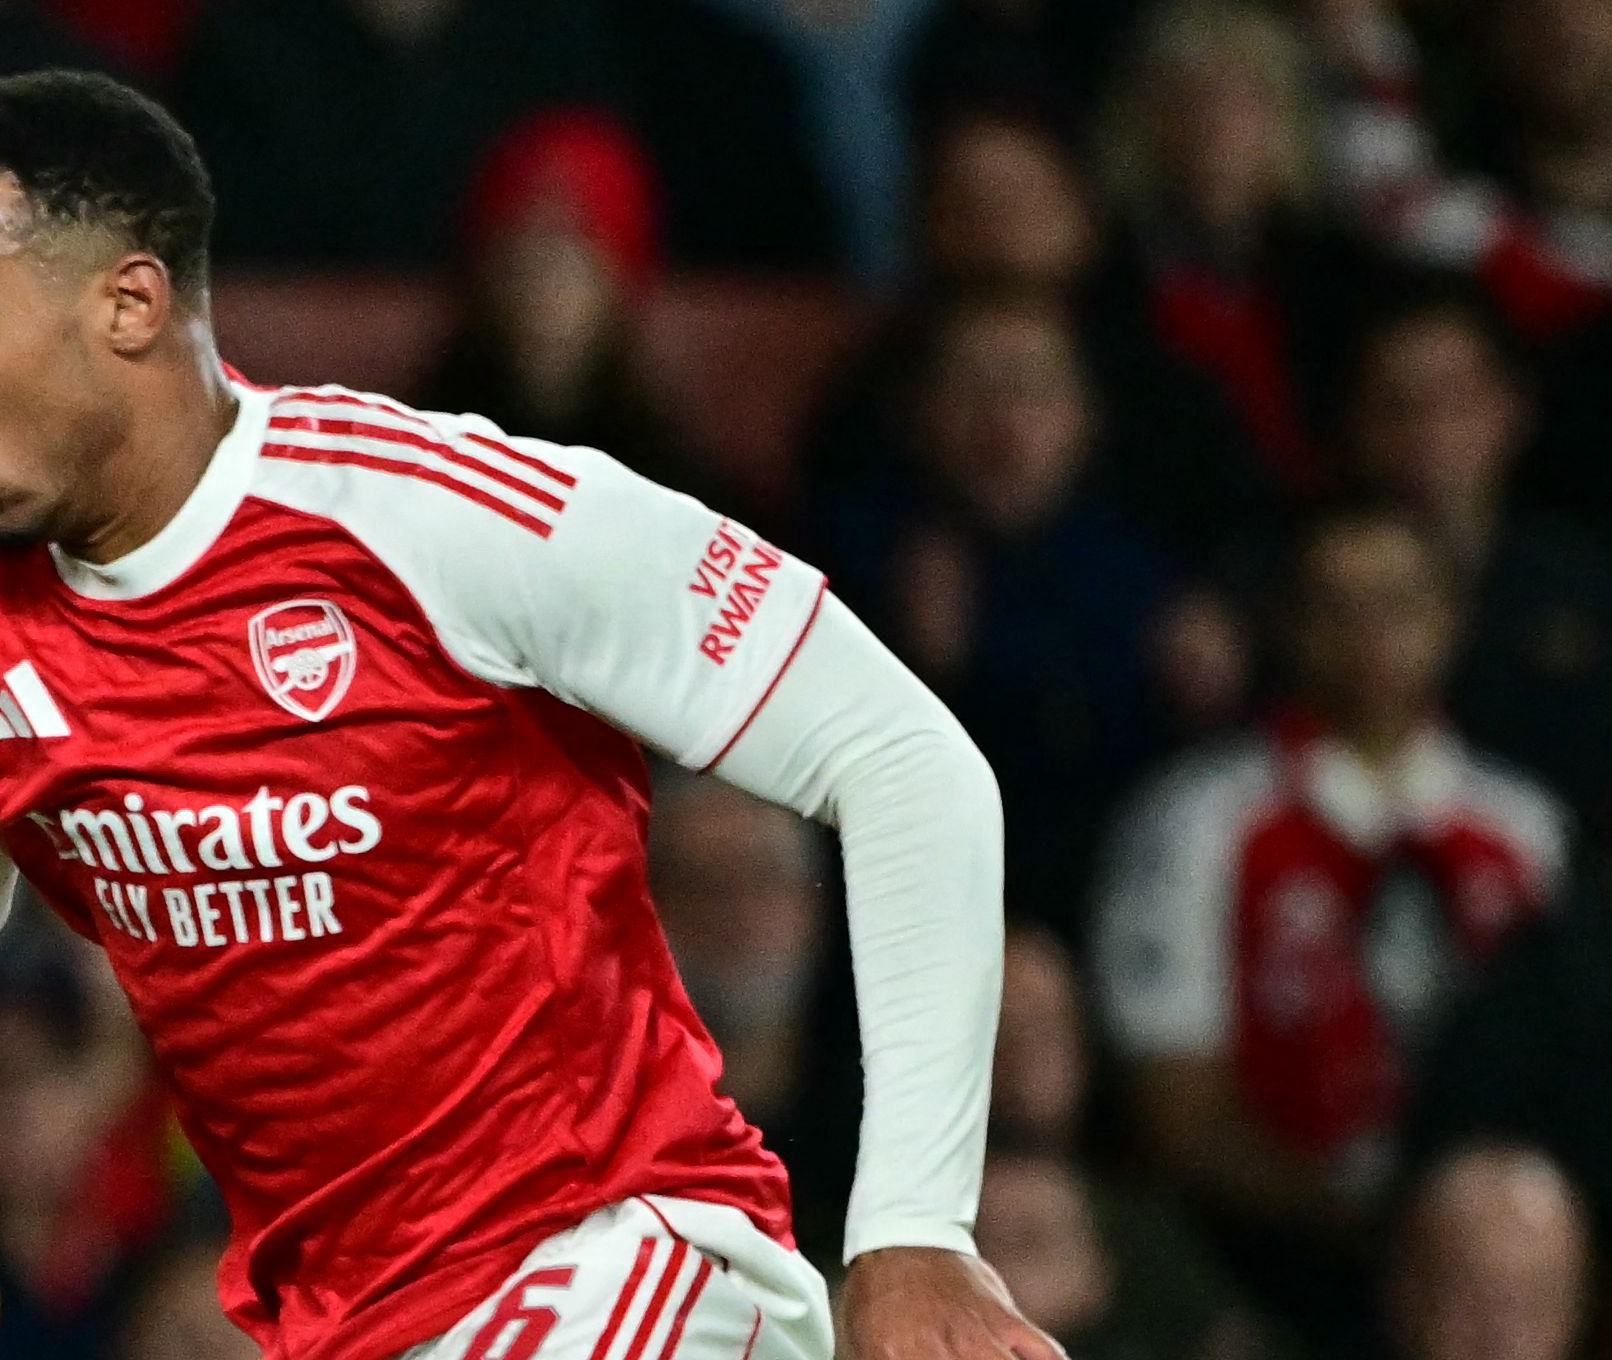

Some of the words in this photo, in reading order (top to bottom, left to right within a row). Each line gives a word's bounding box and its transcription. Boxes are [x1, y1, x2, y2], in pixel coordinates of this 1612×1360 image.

[699, 543, 783, 667] RWAN
[94, 877, 158, 942] FLY
[162, 872, 343, 948] BETTER
